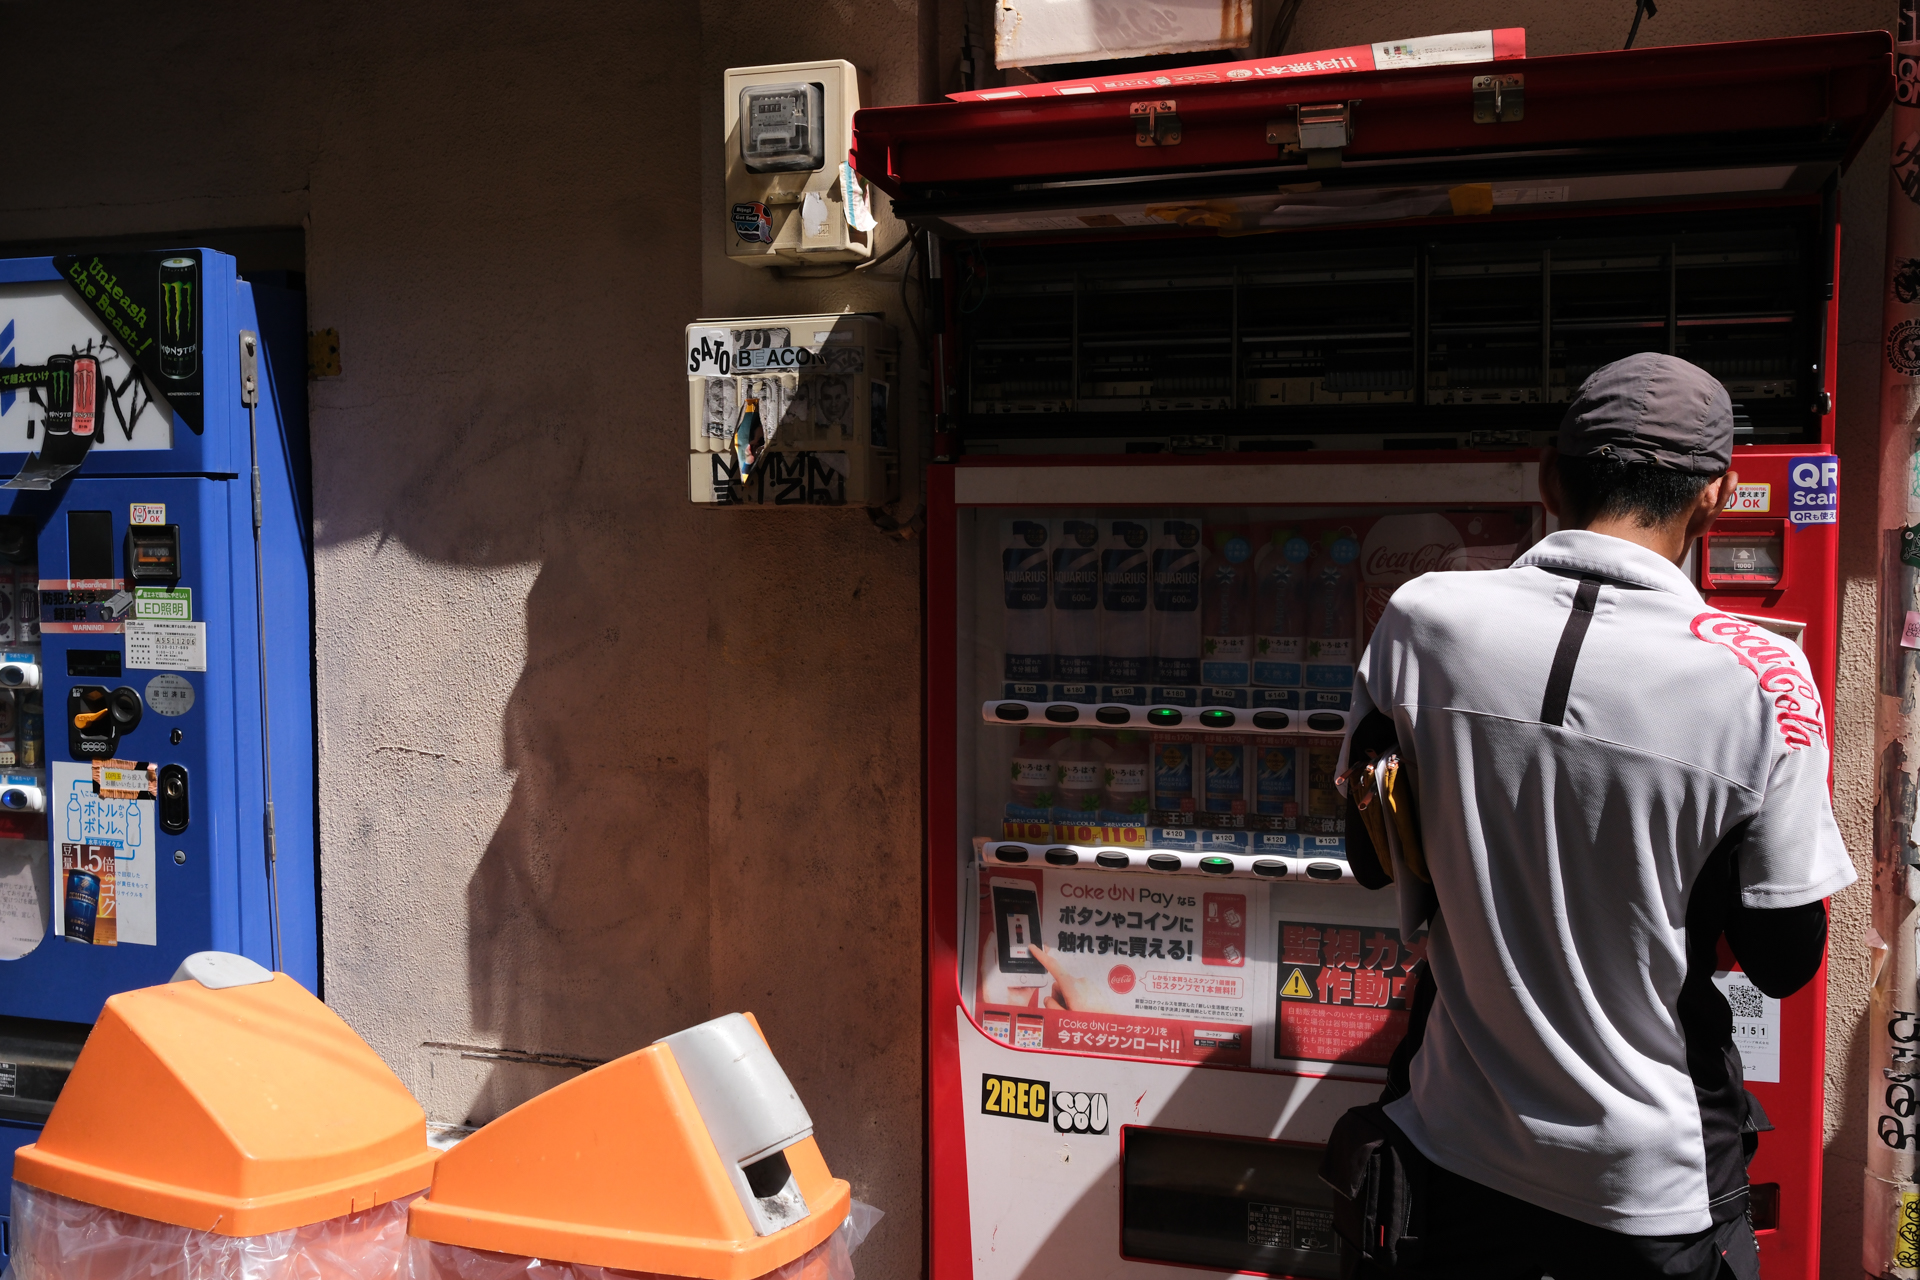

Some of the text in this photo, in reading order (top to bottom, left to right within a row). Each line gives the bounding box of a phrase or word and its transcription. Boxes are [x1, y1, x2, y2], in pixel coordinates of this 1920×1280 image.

[89, 257, 147, 329] Unleash
[69, 262, 97, 299] the
[96, 292, 153, 356] Beast!
[690, 336, 730, 375] SATO
[738, 348, 827, 367] BEACON
[0, 370, 50, 385] で超えていけ
[1792, 463, 1838, 489] QR
[1743, 499, 1761, 508] OK
[1793, 491, 1836, 506] Scan
[150, 515, 160, 523] OK
[1794, 512, 1837, 521] QRも使え
[1004, 571, 1046, 583] AQUARIUS
[1054, 571, 1097, 583] AQUARIUS
[1103, 572, 1146, 584] AQUARIUS
[1154, 572, 1198, 585] AQUARIUS
[137, 603, 184, 617] LED照明
[155, 637, 196, 646] A5511206
[1012, 665, 1039, 674] 水分補給
[1060, 666, 1089, 675] 水分補給
[1109, 668, 1137, 676] 水分補給
[1160, 668, 1188, 677] 水分補給
[1690, 612, 1829, 750] Coca-Cola
[1267, 691, 1286, 699] ¥140
[1320, 694, 1338, 702] ¥140
[105, 772, 143, 781] 10円玉から投入
[1310, 774, 1336, 783] GOLD
[105, 781, 148, 789] お願いいたします
[1168, 812, 1194, 826] 王道
[1219, 814, 1245, 828] 王道
[1270, 817, 1297, 830] 王道
[84, 819, 124, 836] ボトルへ
[73, 845, 102, 873] 1.5
[115, 880, 149, 889] が責任をもって
[1060, 883, 1105, 901] Coke
[1139, 889, 1174, 908] Pay
[1177, 896, 1196, 907] なら
[1059, 906, 1194, 933] ボタンやコインに
[1057, 931, 1193, 962] 触れずに買える!
[1152, 982, 1237, 996] 15スタンプで1本無料!!
[1315, 966, 1419, 1011] 作動中
[1057, 1030, 1180, 1054] 今すぐダウンロード!!
[985, 1078, 1046, 1119] 2REC
